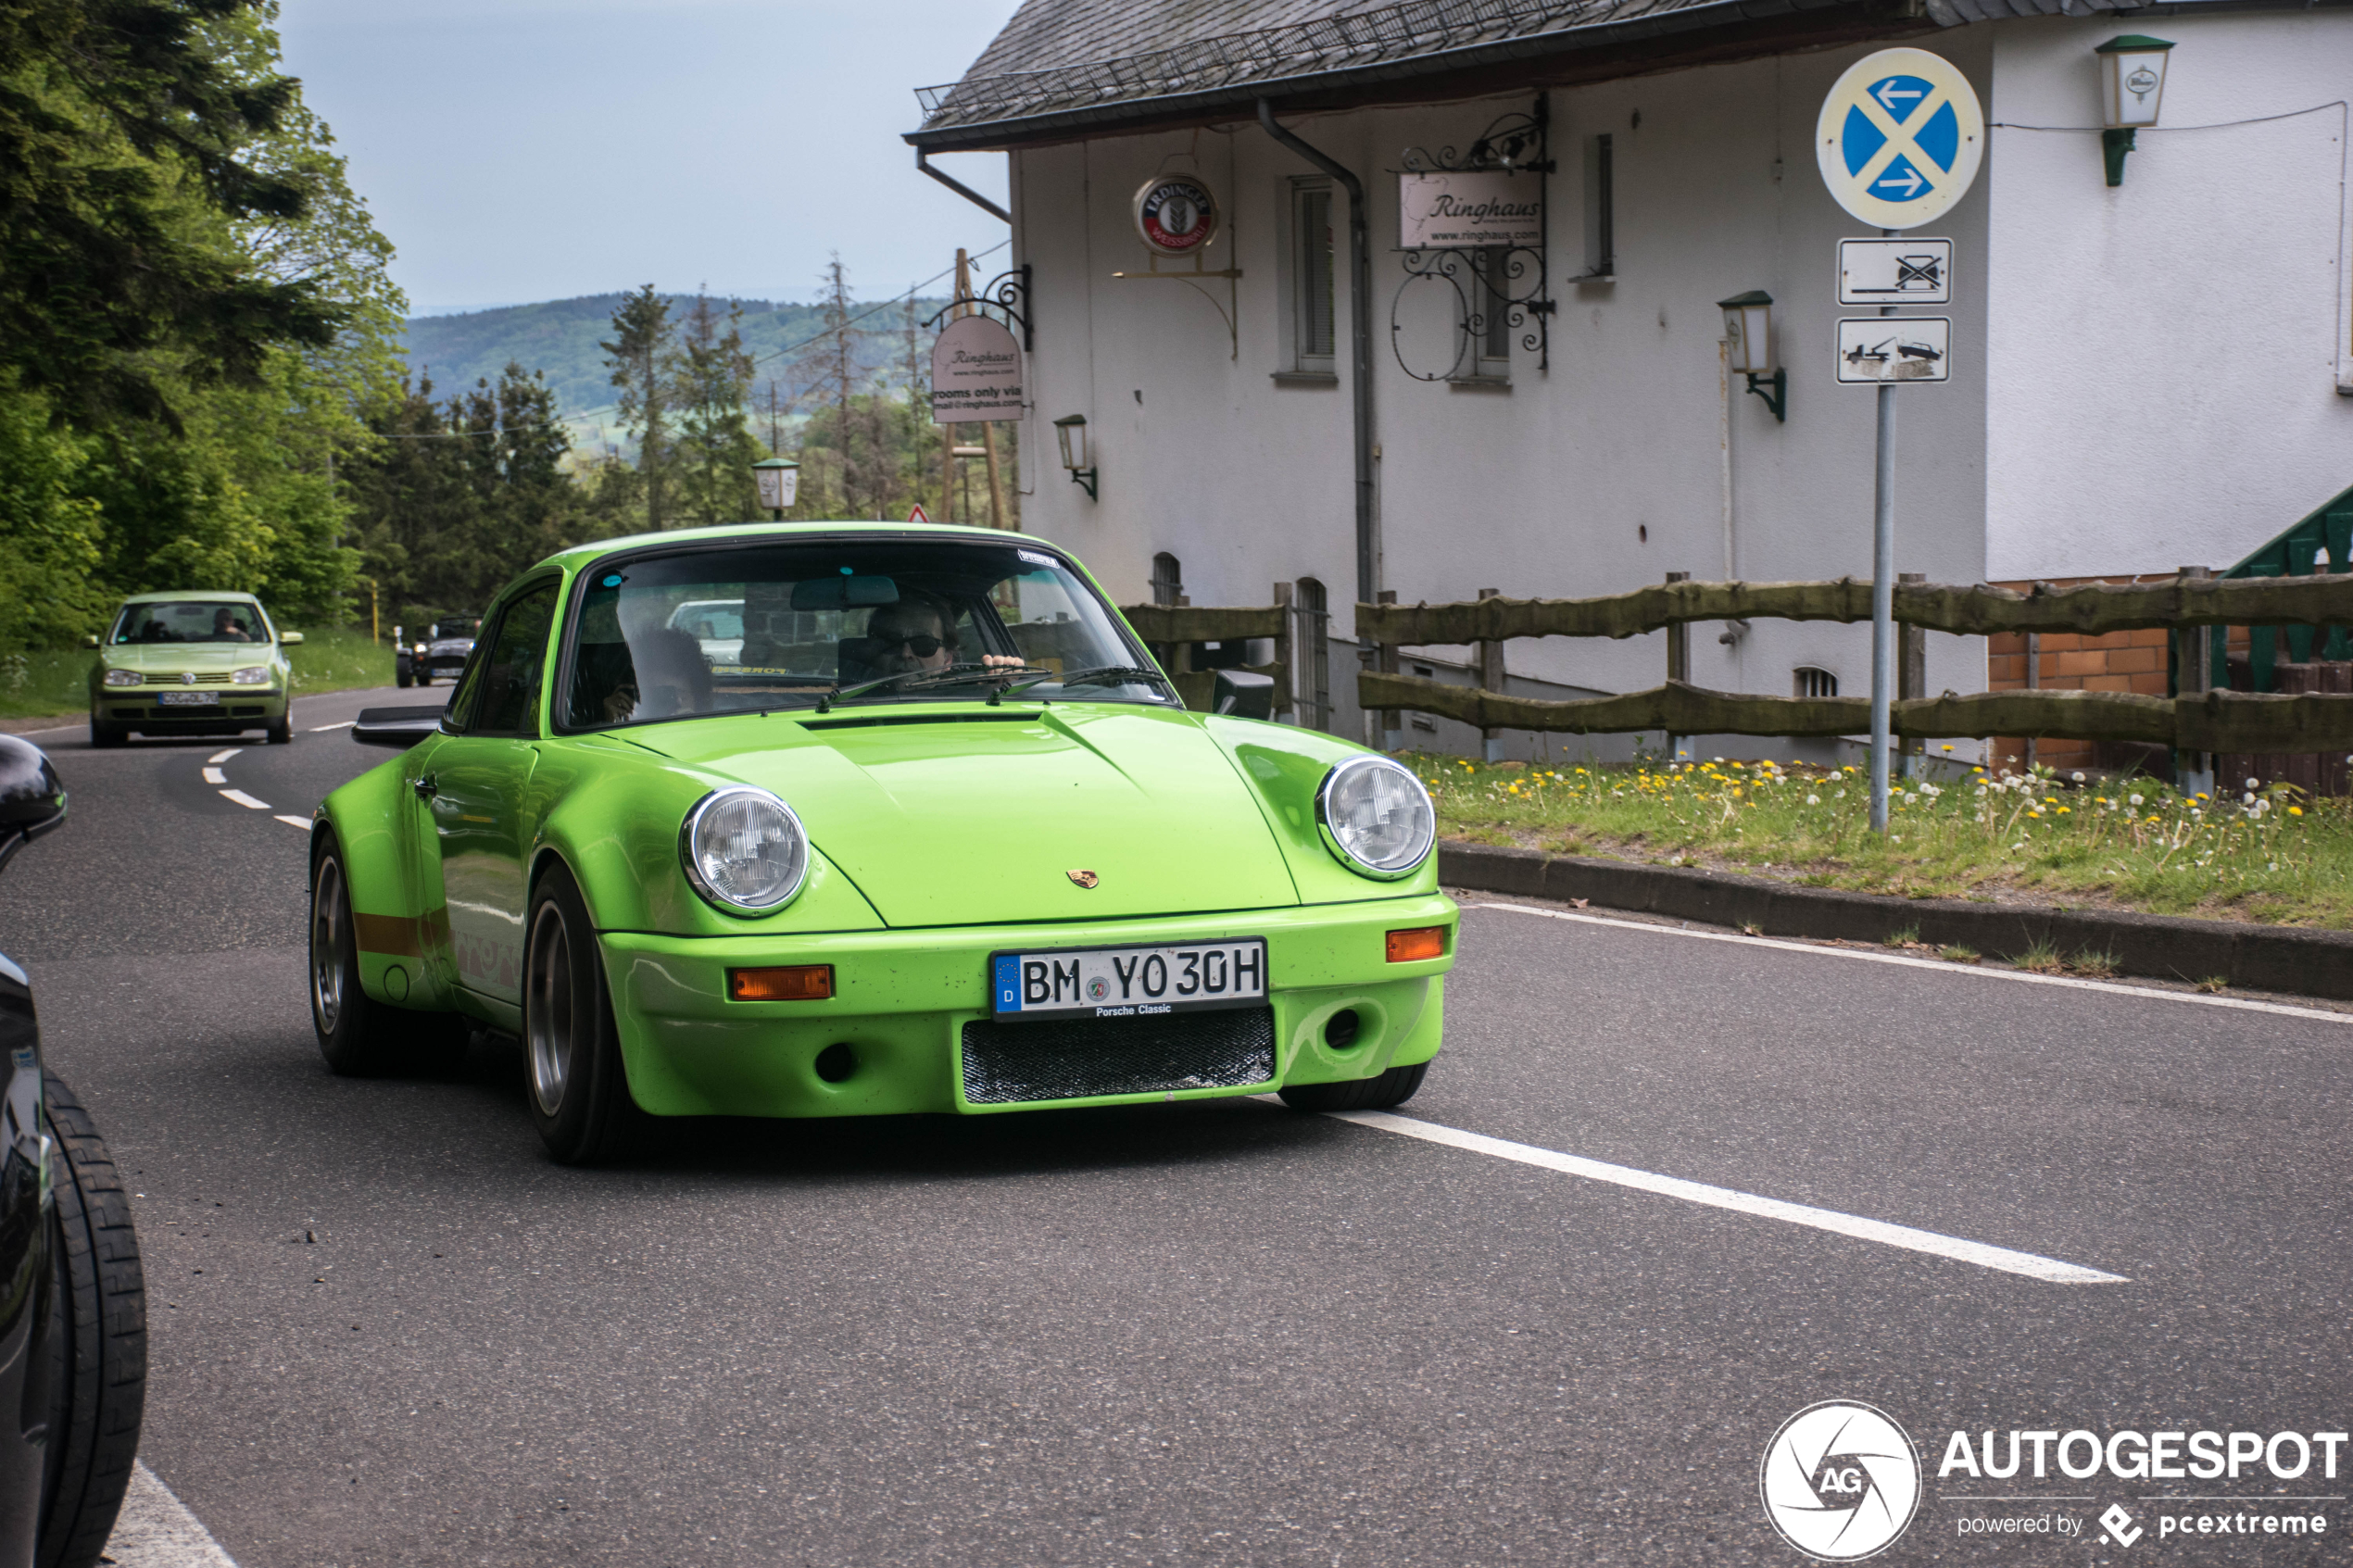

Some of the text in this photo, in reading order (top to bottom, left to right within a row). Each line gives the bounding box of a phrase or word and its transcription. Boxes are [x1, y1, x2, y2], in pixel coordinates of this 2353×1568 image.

[1146, 184, 1207, 212] ERDINGER
[1429, 194, 1540, 224] Ringhaus
[1430, 231, 1539, 242] www.ringhaus.com
[951, 350, 1014, 367] Ringhaus
[934, 386, 1022, 398] rooms only via
[1004, 989, 1013, 1003] D
[1024, 959, 1081, 1004] BM
[1096, 1004, 1172, 1017] Porsche Classic
